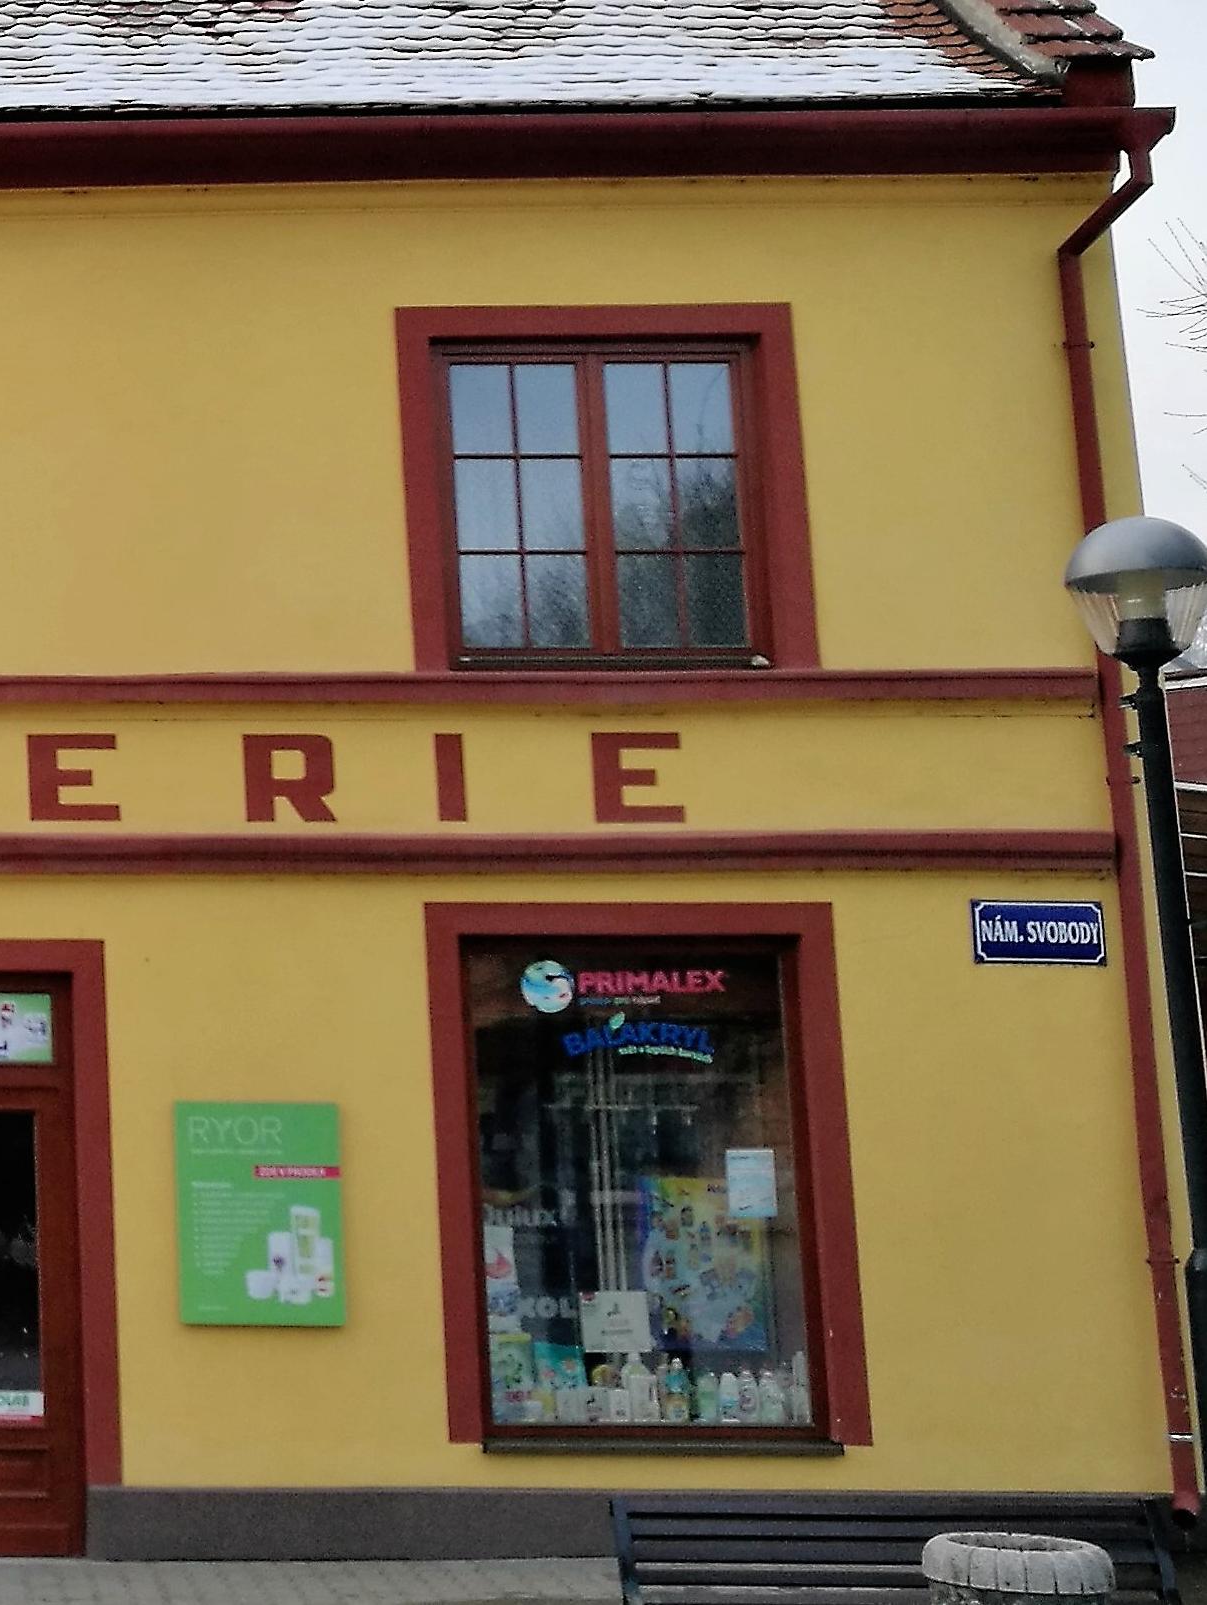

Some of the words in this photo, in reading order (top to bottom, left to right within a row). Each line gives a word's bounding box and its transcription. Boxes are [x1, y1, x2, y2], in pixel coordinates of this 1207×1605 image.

[980, 914, 1024, 942] NÁM.
[1026, 920, 1099, 944] SVOBODY
[577, 969, 729, 995] PRIMALEX
[561, 1020, 715, 1057] BALAKRYL
[186, 1115, 283, 1144] RYOR
